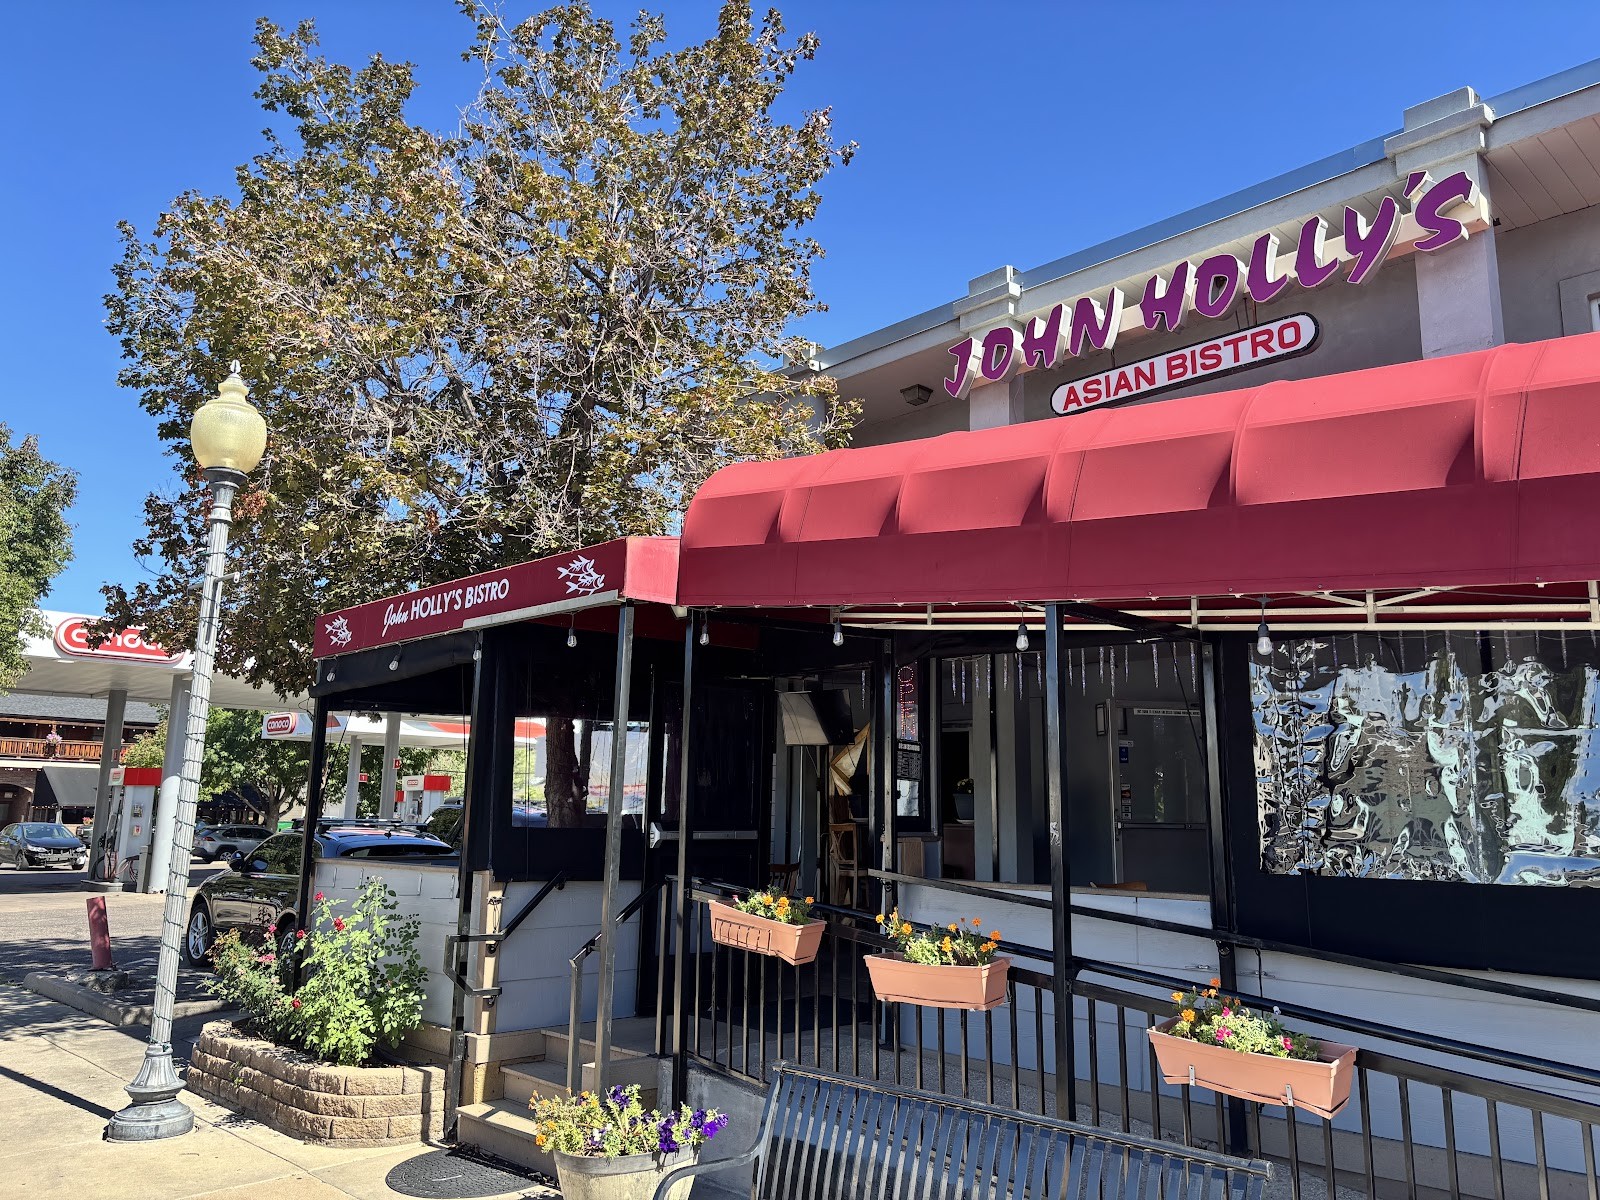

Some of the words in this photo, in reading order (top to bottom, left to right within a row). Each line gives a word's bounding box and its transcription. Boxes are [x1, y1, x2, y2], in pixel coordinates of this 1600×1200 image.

[943, 286, 1121, 399] JOHN
[1139, 170, 1475, 333] HOLLY'S
[1062, 362, 1156, 412] ASIAN
[1165, 320, 1302, 382] BISTRO
[381, 601, 409, 638] John
[410, 588, 464, 621] HOLLY'S
[464, 578, 510, 609] BISTRO
[897, 665, 916, 737] OPEN
